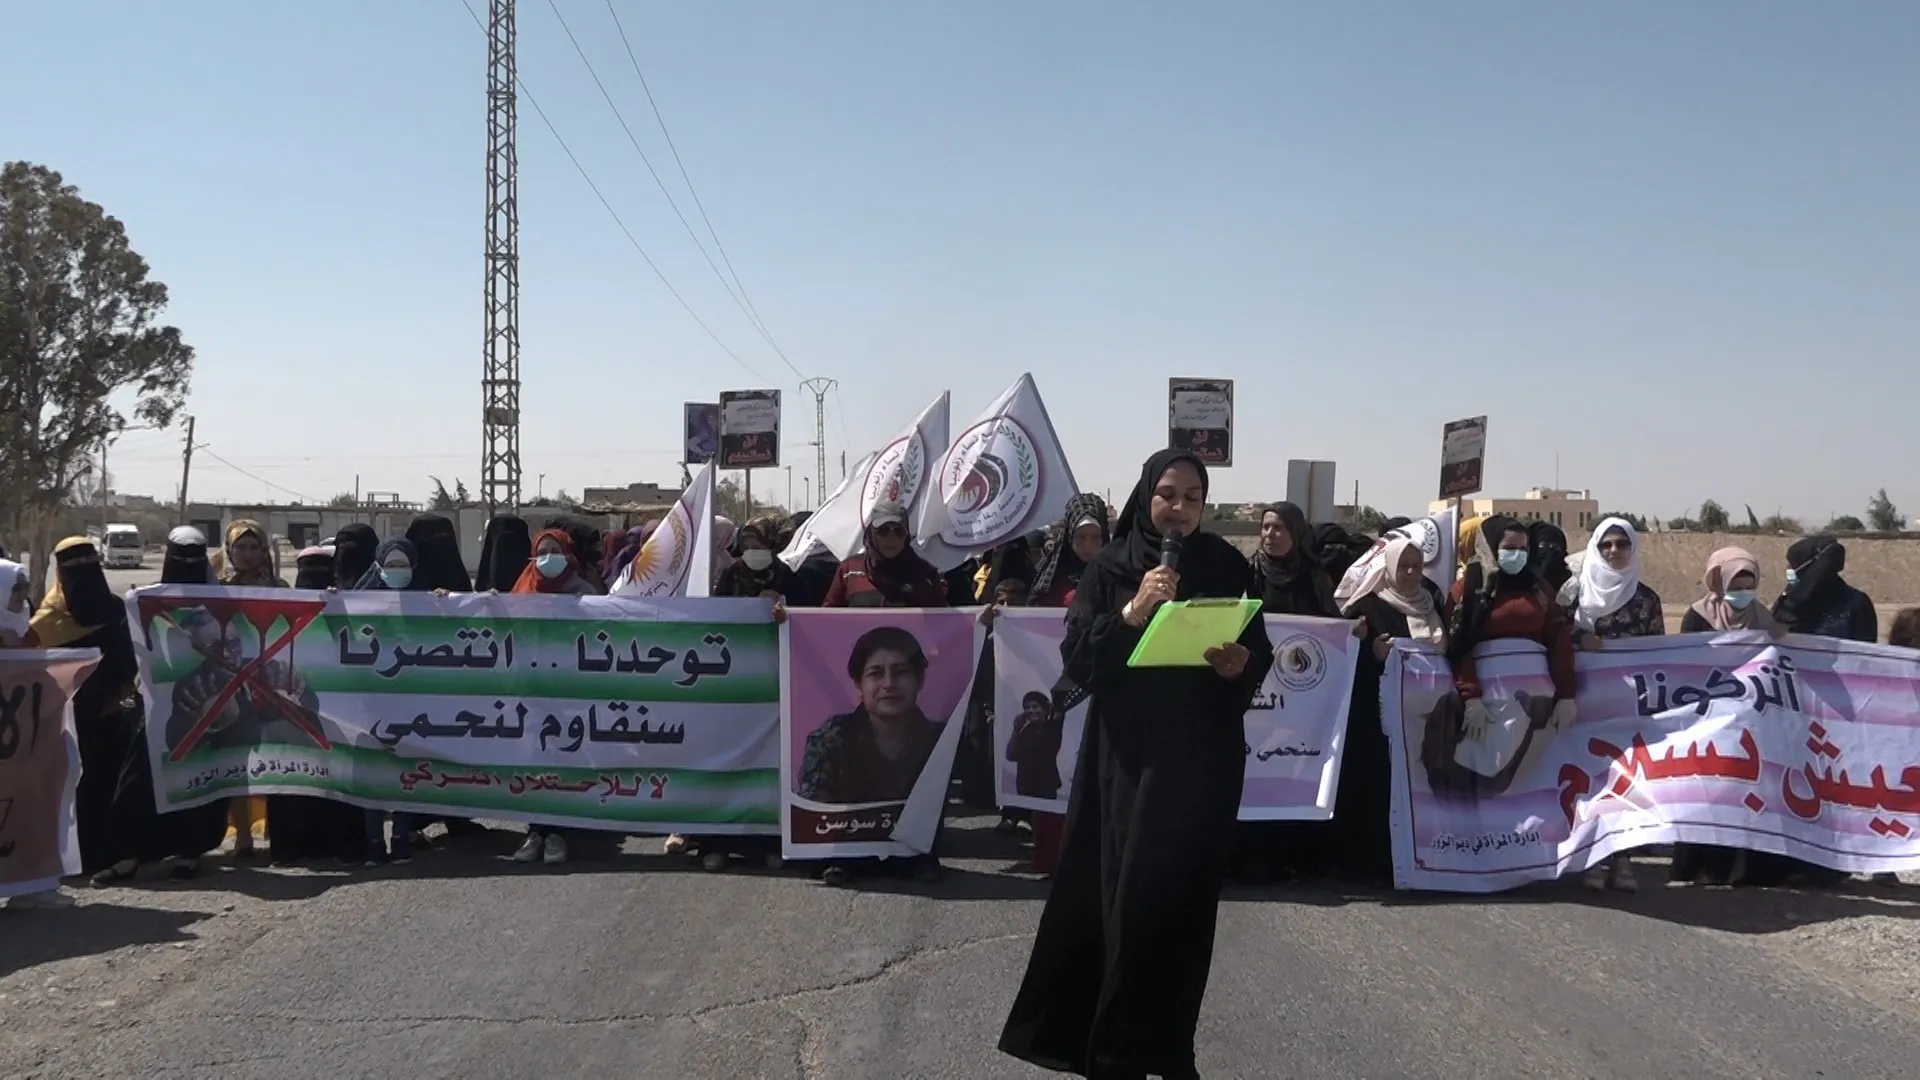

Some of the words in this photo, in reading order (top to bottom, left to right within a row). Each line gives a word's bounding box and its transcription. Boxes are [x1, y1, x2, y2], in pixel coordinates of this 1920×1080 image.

[338, 624, 513, 678] انتصرنا
[576, 631, 732, 687] توحدنا
[370, 699, 529, 752] لنحمي
[539, 701, 685, 753] سنقاوم
[250, 758, 267, 777] في
[649, 775, 669, 799] لا
[815, 814, 876, 835] سوسن
